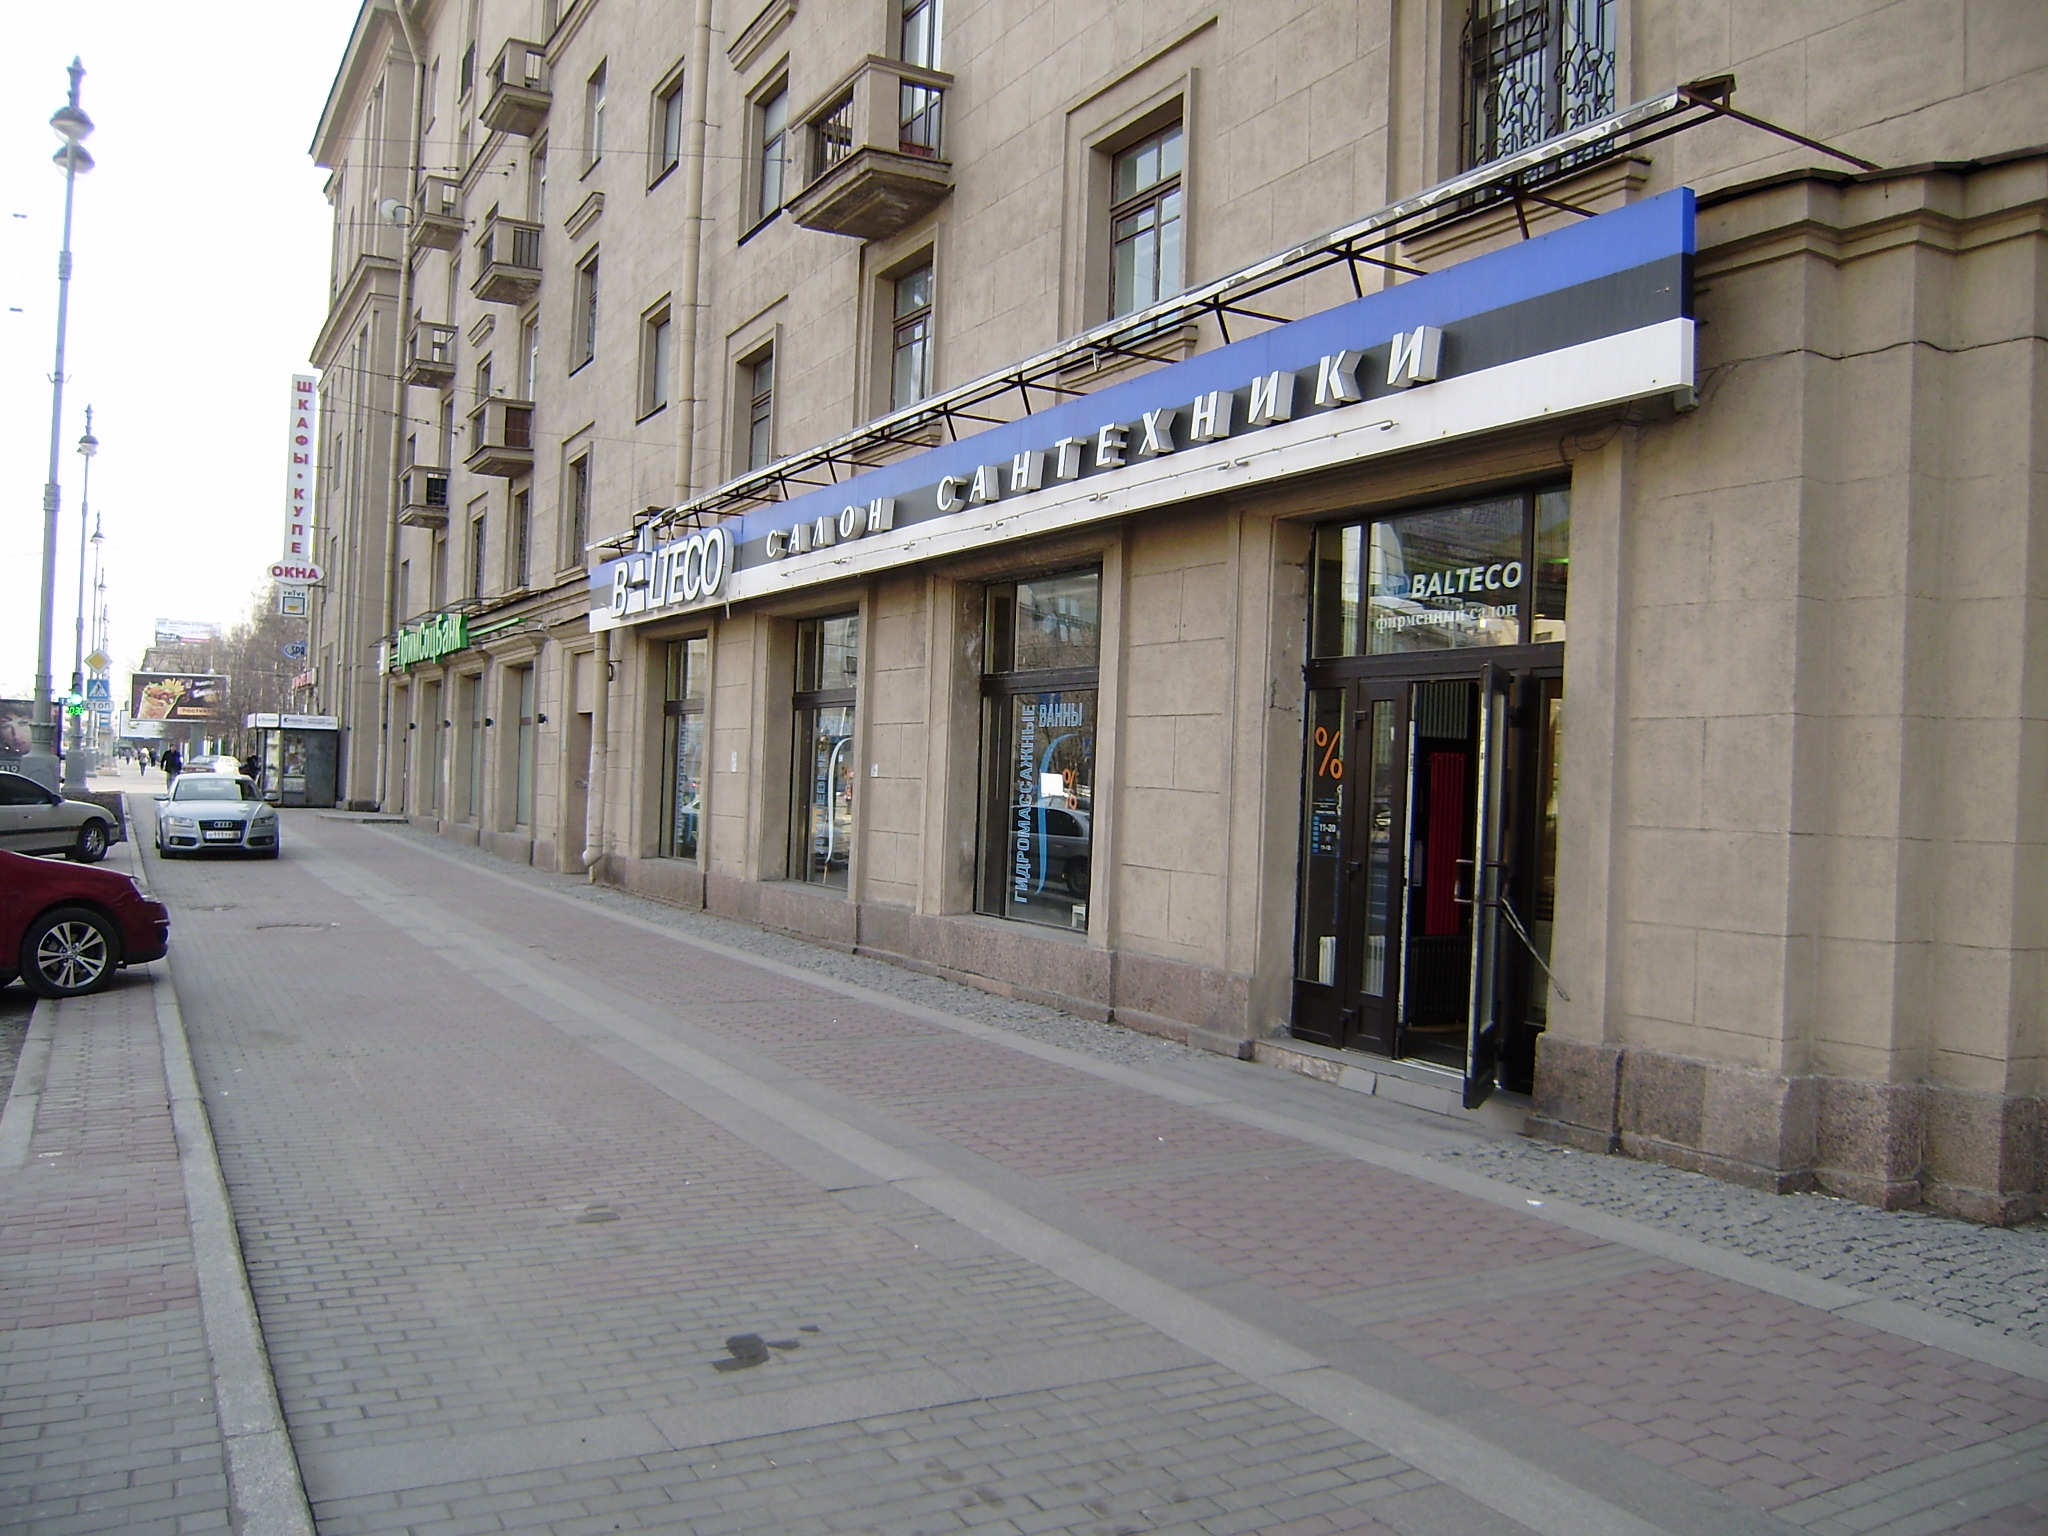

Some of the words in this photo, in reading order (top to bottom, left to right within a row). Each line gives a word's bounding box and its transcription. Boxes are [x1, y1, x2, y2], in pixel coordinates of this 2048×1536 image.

[766, 497, 896, 558] САЛОН
[935, 325, 1442, 513] САНТЕХНИКИ
[271, 565, 319, 579] ОКНА
[1411, 561, 1523, 599] BALTECO
[1376, 604, 1465, 633] фирменный
[1469, 604, 1517, 621] салон
[397, 613, 464, 673] ПримСоцБанк
[1039, 702, 1083, 728] ВАННЫ
[1014, 704, 1035, 904] ГИДРОМАССАЖНЫЕ
